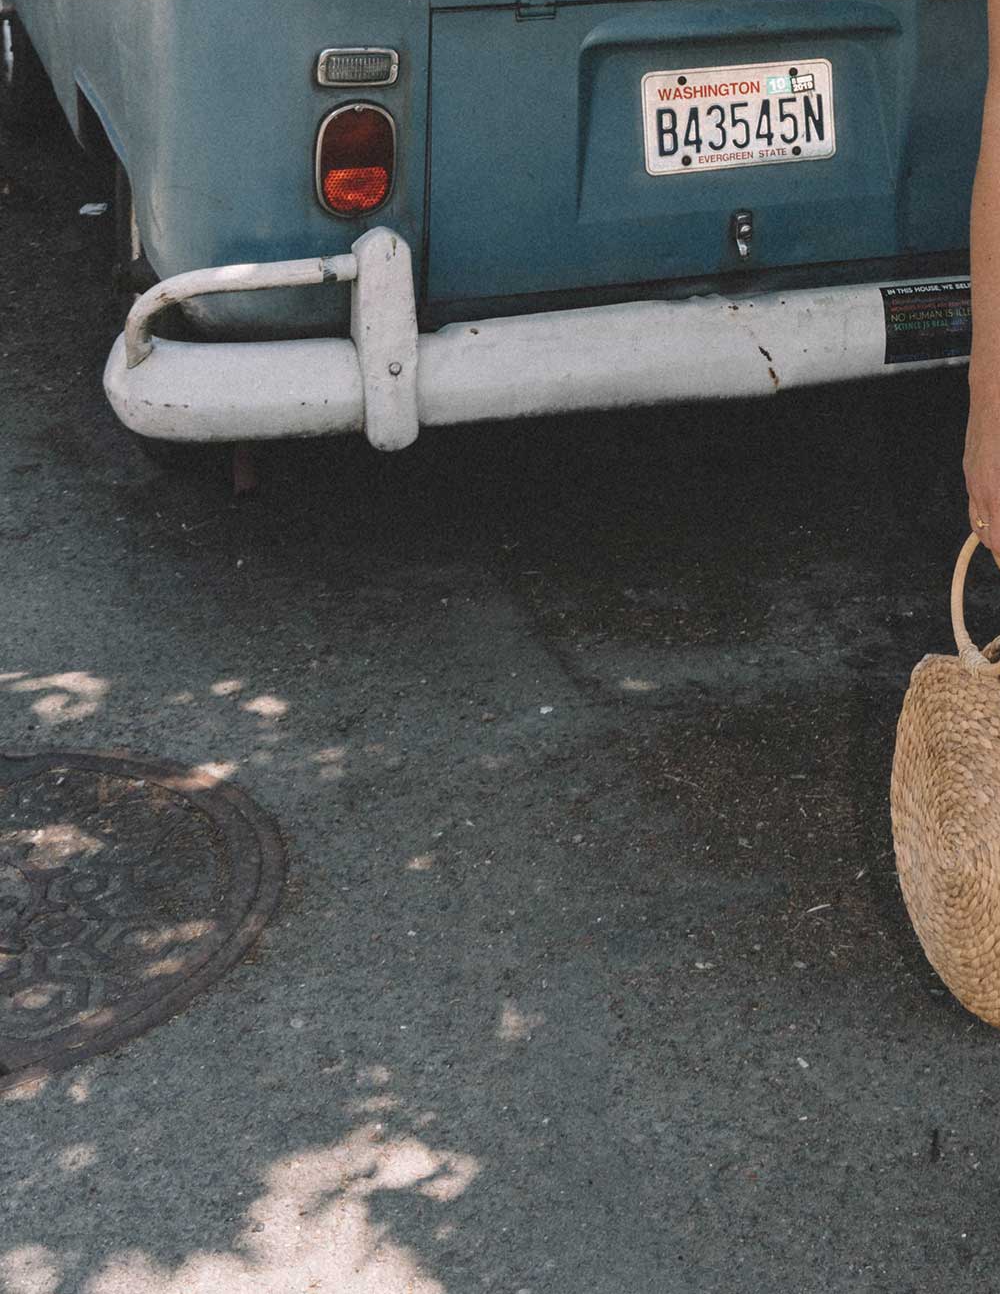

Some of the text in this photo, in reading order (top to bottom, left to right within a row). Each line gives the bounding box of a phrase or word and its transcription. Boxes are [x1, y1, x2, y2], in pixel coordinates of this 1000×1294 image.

[657, 81, 761, 101] WASHINGTON
[769, 77, 786, 91] 10
[793, 81, 813, 92] 2019
[656, 93, 825, 157] B43545N
[698, 147, 788, 164] EVERGREEN STATE
[891, 314, 906, 322] NO
[909, 309, 943, 321] HUMAN
[956, 307, 972, 316] ILLE
